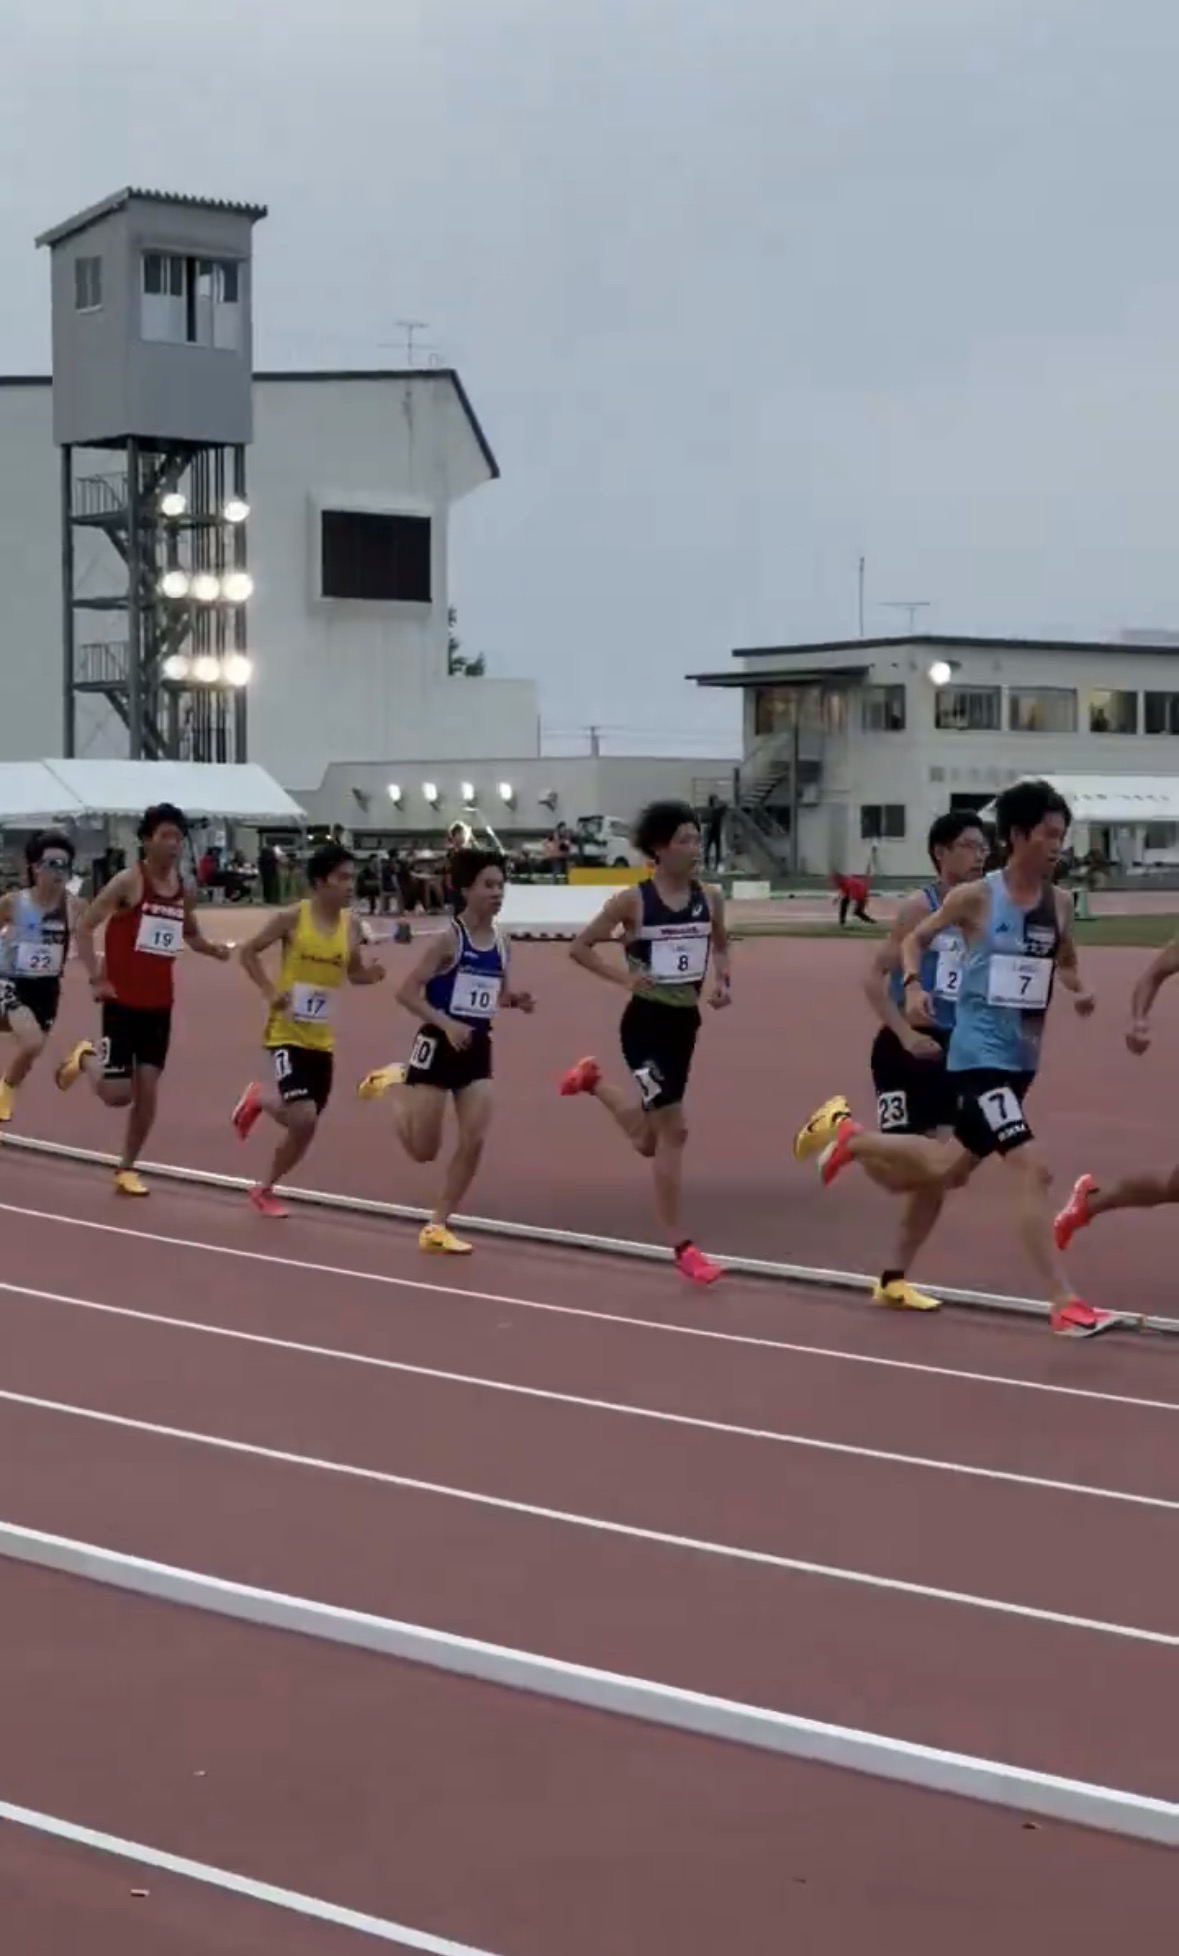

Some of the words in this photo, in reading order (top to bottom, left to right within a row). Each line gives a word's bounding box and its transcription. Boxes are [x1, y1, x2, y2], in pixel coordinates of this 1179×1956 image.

[153, 931, 174, 947] 19
[29, 955, 51, 969] 22
[677, 954, 689, 972] 8
[947, 971, 958, 990] 2
[1018, 975, 1032, 995] 7
[305, 998, 326, 1015] 17
[470, 990, 491, 1009] 10
[879, 1097, 905, 1123] 23
[988, 1093, 1008, 1120] 7
